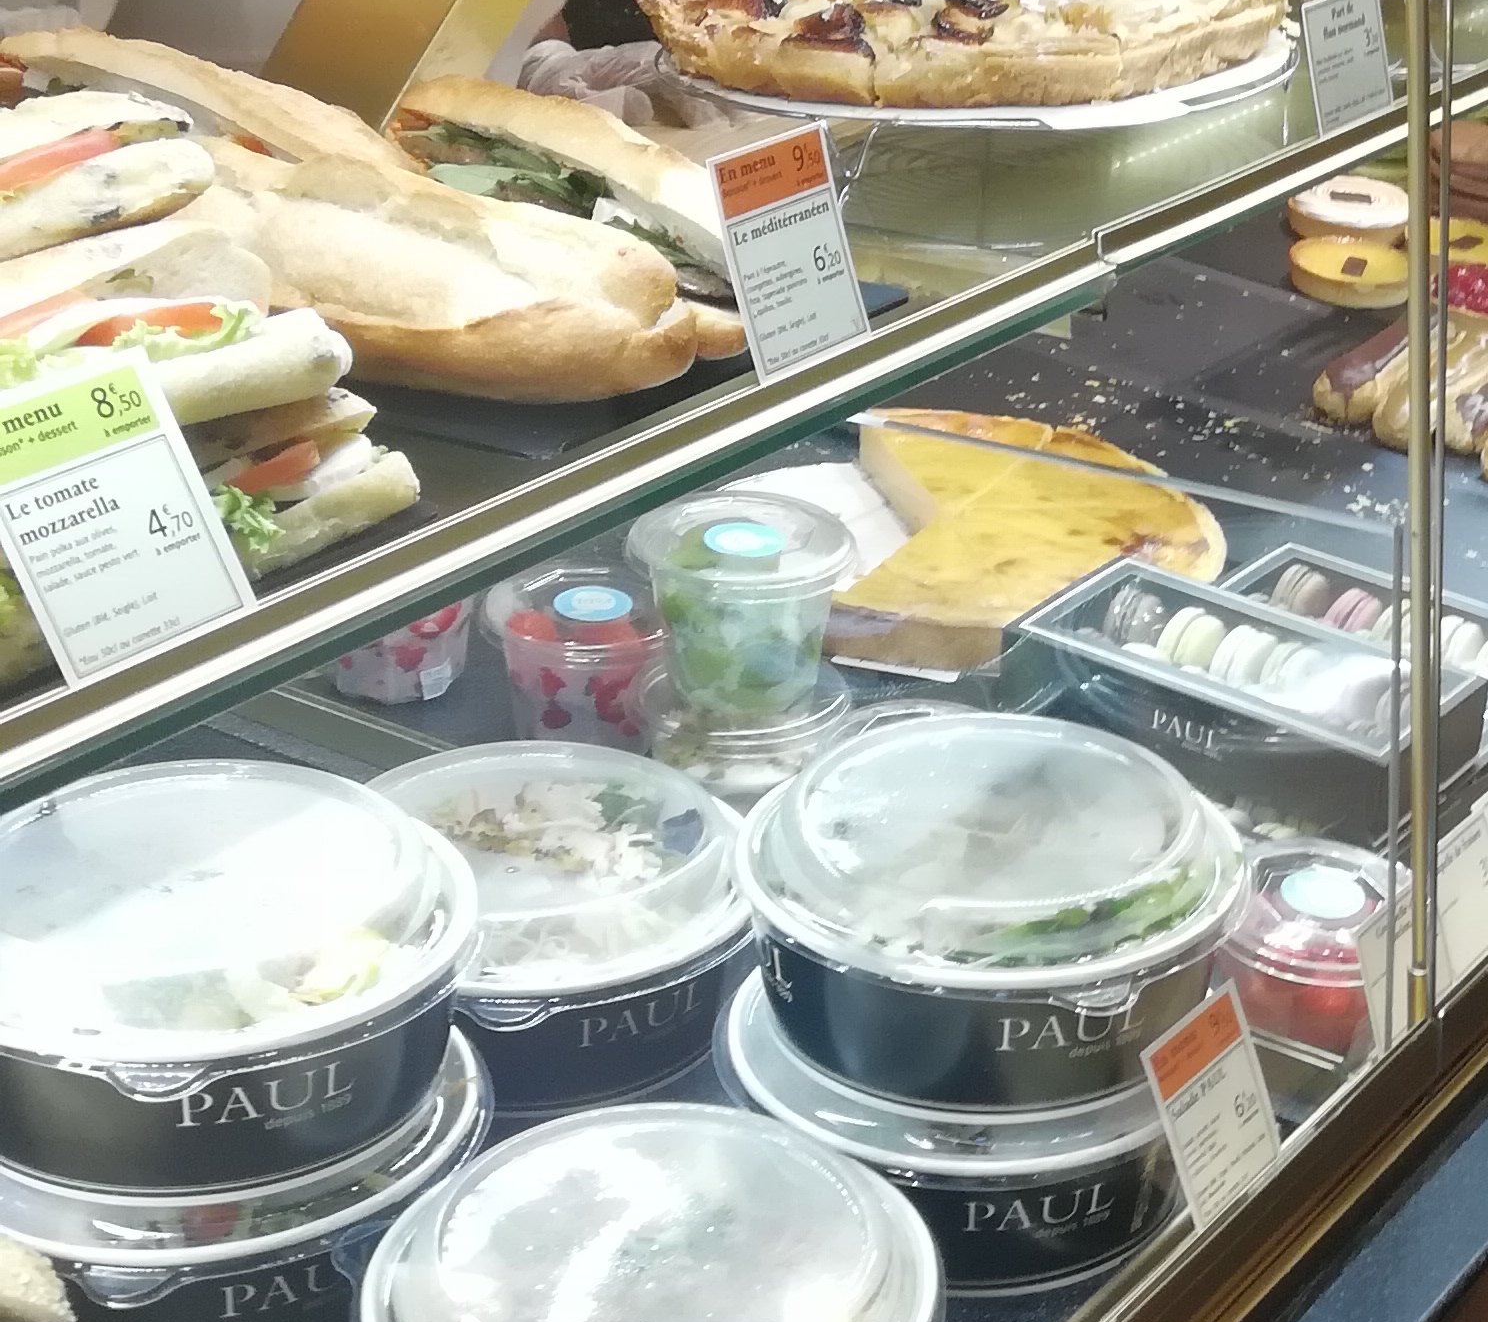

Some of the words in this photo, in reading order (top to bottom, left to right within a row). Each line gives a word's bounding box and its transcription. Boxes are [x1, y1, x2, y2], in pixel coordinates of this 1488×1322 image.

[719, 167, 737, 184] En
[741, 155, 776, 177] menu
[733, 230, 748, 246] Le
[2, 403, 63, 435] menu
[38, 420, 78, 443] dessert
[112, 415, 152, 435] emporter
[4, 502, 32, 521] Le
[34, 476, 100, 511] tomate
[19, 496, 121, 546] mozzarella
[163, 532, 202, 554] emporter
[1151, 708, 1219, 751] PAUL
[579, 981, 701, 1048] PAUL
[994, 1008, 1145, 1052] PAUL
[175, 1061, 356, 1128] PAUL
[264, 1109, 315, 1130] depuis
[962, 1181, 1116, 1232] PAUL
[219, 1263, 340, 1319] PAU
